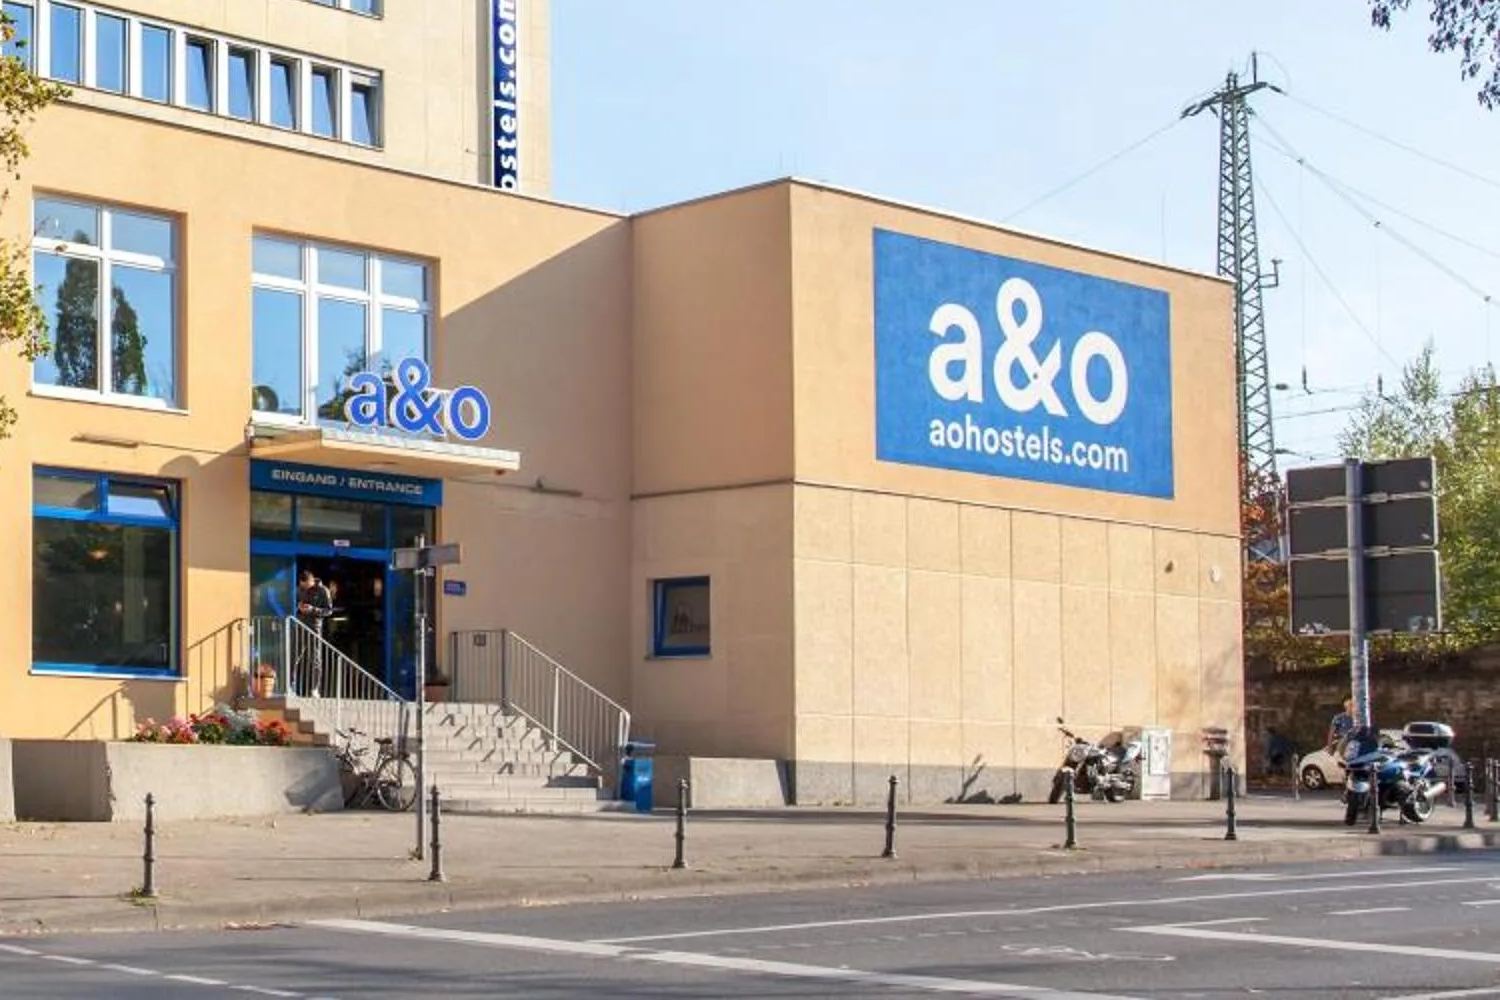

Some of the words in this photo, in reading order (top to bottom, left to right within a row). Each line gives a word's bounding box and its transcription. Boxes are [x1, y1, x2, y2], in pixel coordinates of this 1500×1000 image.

[928, 277, 1129, 426] a&o
[349, 357, 491, 441] a&o
[929, 413, 1130, 473] aohostels.com
[271, 469, 337, 486] EINGANG
[348, 477, 424, 495] ENTRANCE
